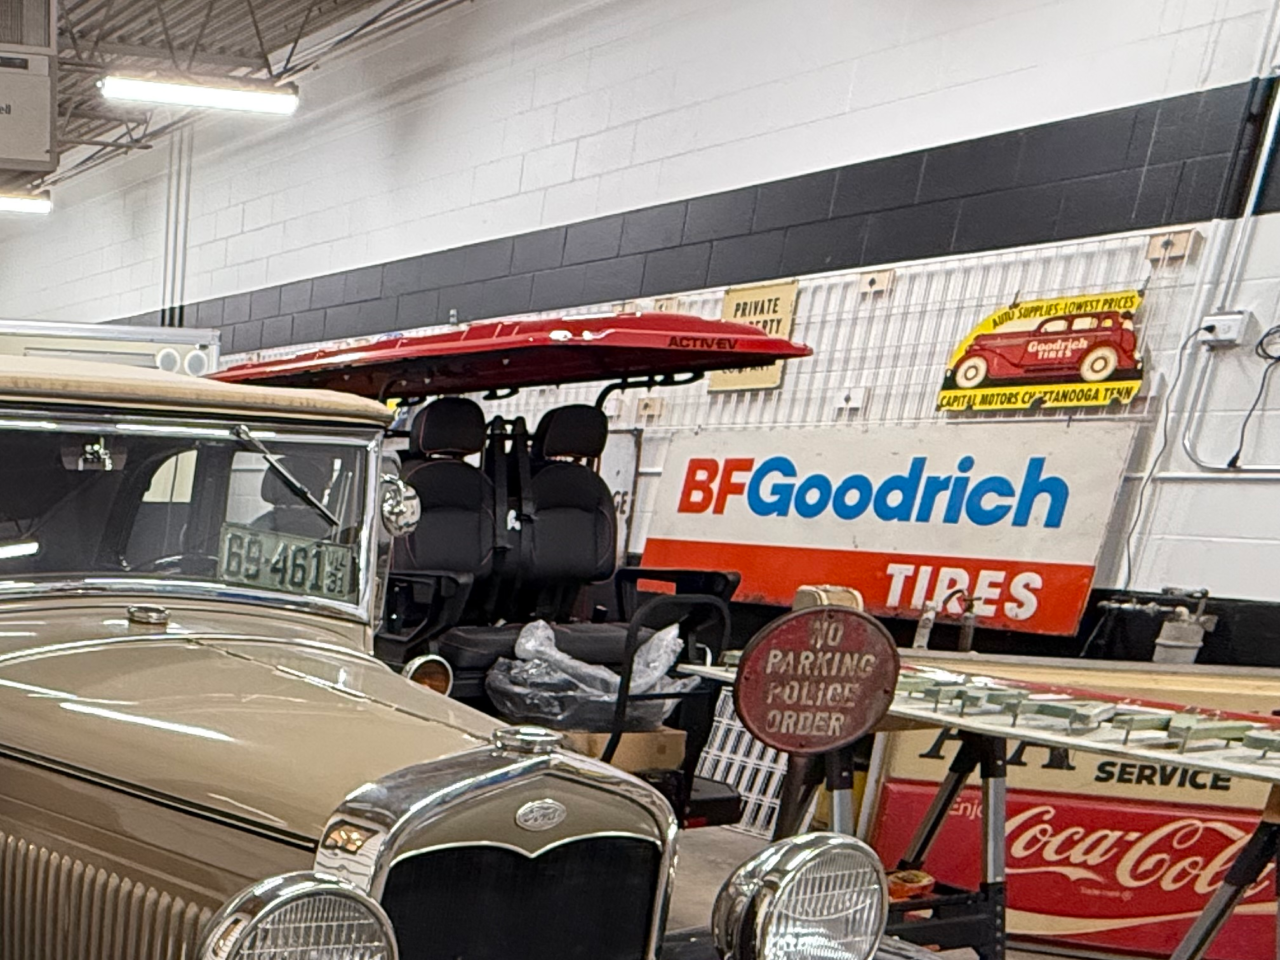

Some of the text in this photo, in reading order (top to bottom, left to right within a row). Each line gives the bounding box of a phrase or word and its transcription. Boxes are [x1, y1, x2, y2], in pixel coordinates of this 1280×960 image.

[733, 297, 781, 319] PRIVATE
[991, 311, 1015, 330] AUTO
[1101, 295, 1136, 311] PRICES
[1027, 338, 1089, 353] Goodrich
[1037, 350, 1073, 360] TIRES
[939, 392, 977, 408] CAPITAL
[978, 391, 1020, 407] MOTORS
[1021, 387, 1100, 405] CHTTANOOGA
[677, 454, 1070, 529] BFGoodrich
[885, 562, 1043, 621] TIRES
[810, 620, 845, 649] NO
[765, 649, 877, 678] PARKING
[766, 680, 860, 708] POLICE
[765, 709, 845, 737] ORDER
[1094, 760, 1232, 792] SERVICE
